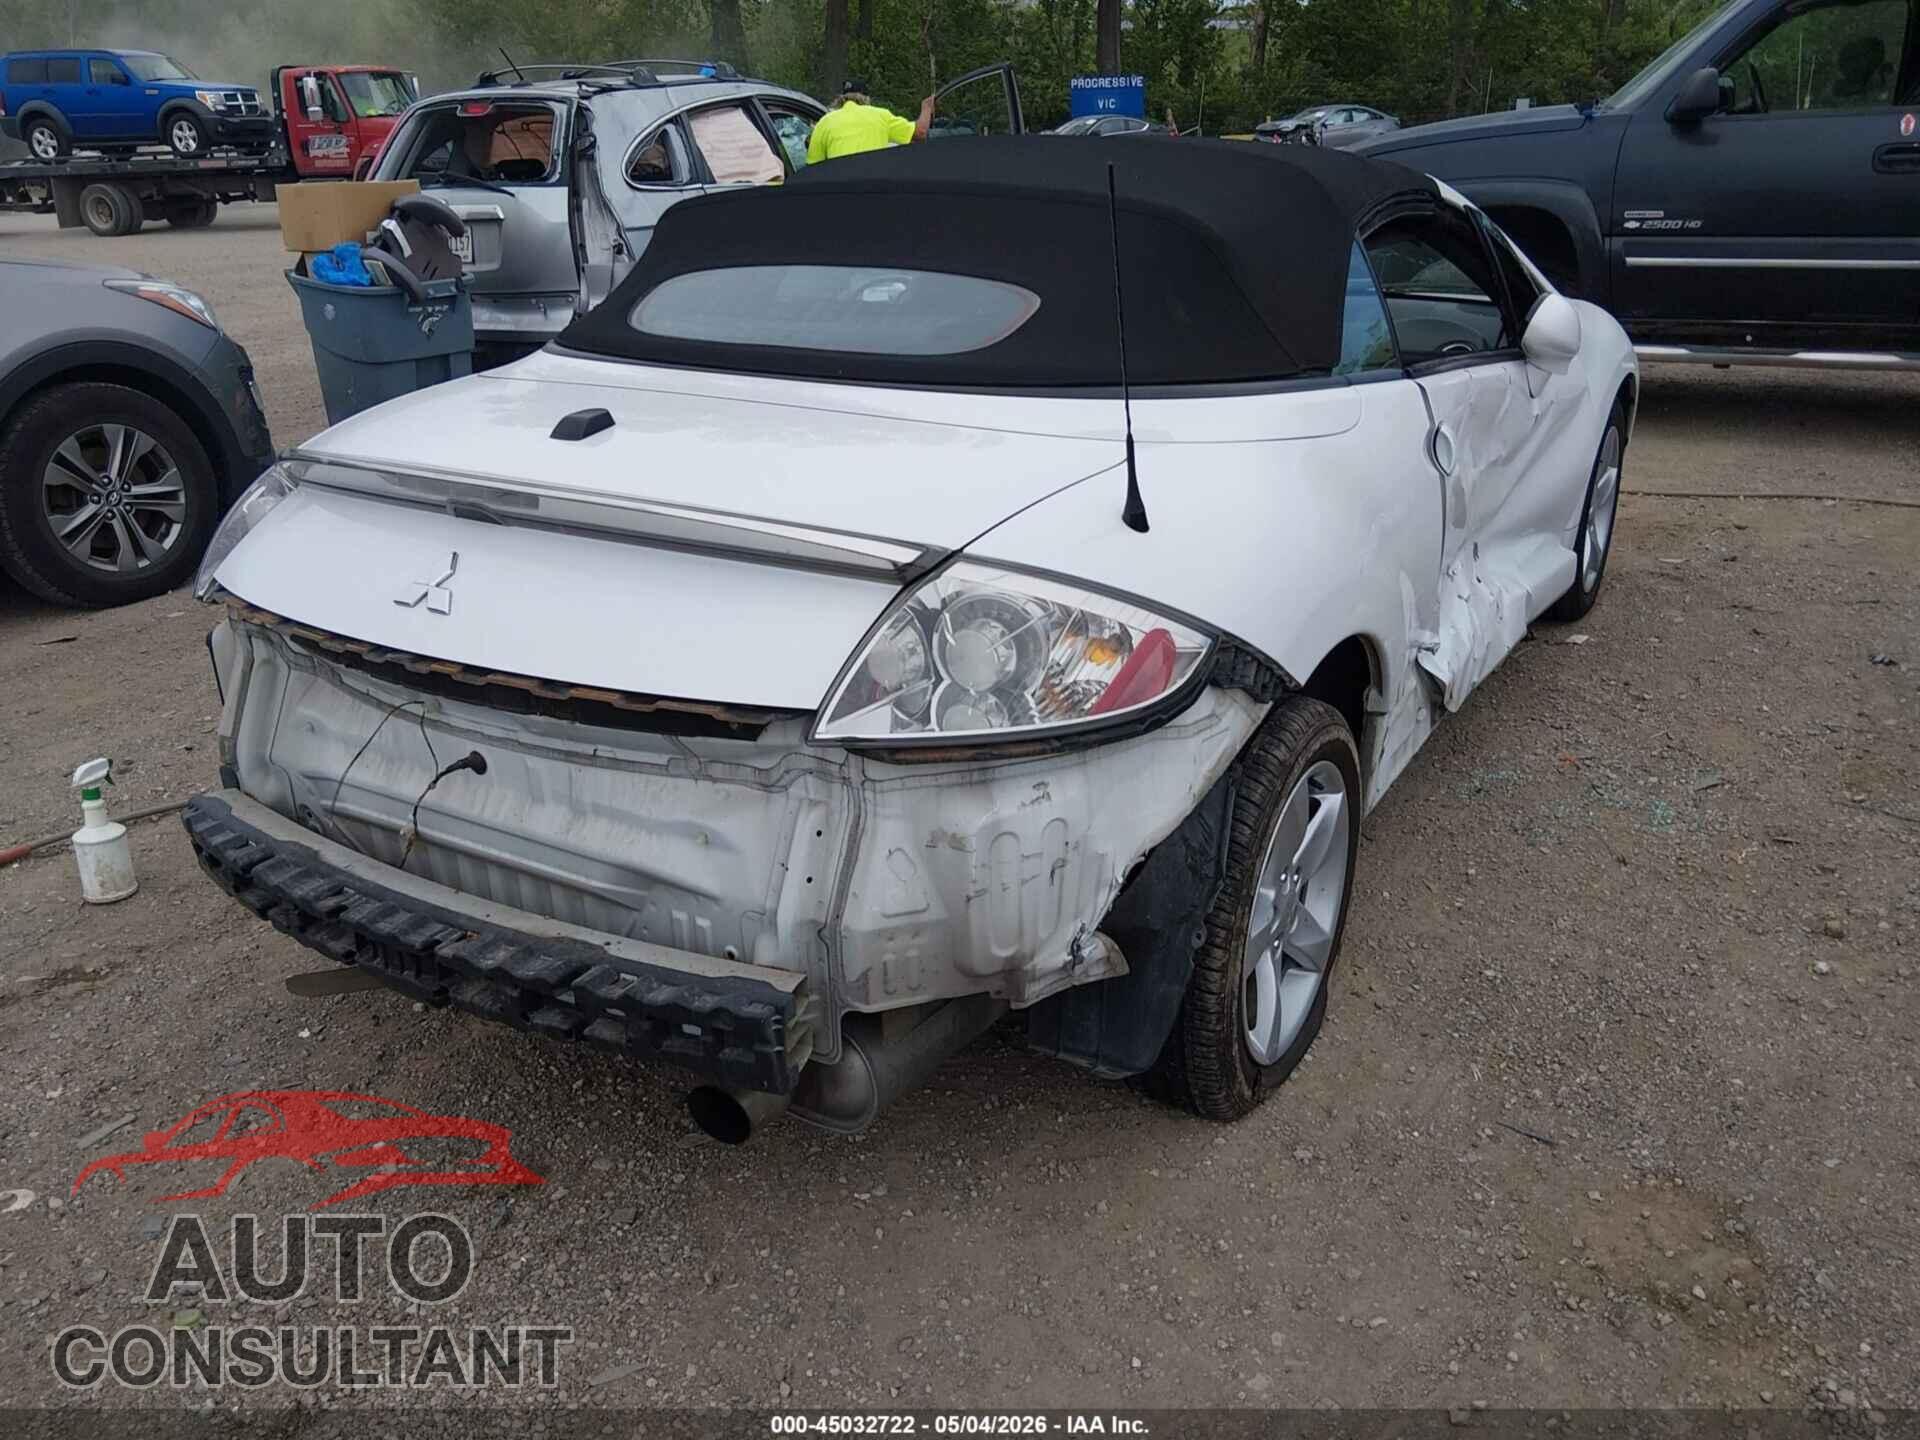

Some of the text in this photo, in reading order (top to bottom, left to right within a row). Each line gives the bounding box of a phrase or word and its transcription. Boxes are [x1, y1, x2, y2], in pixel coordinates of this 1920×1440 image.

[1071, 76, 1144, 88] PROGRESSIVE
[1097, 98, 1116, 109] VIC
[1642, 219, 1703, 229] 2500 HD
